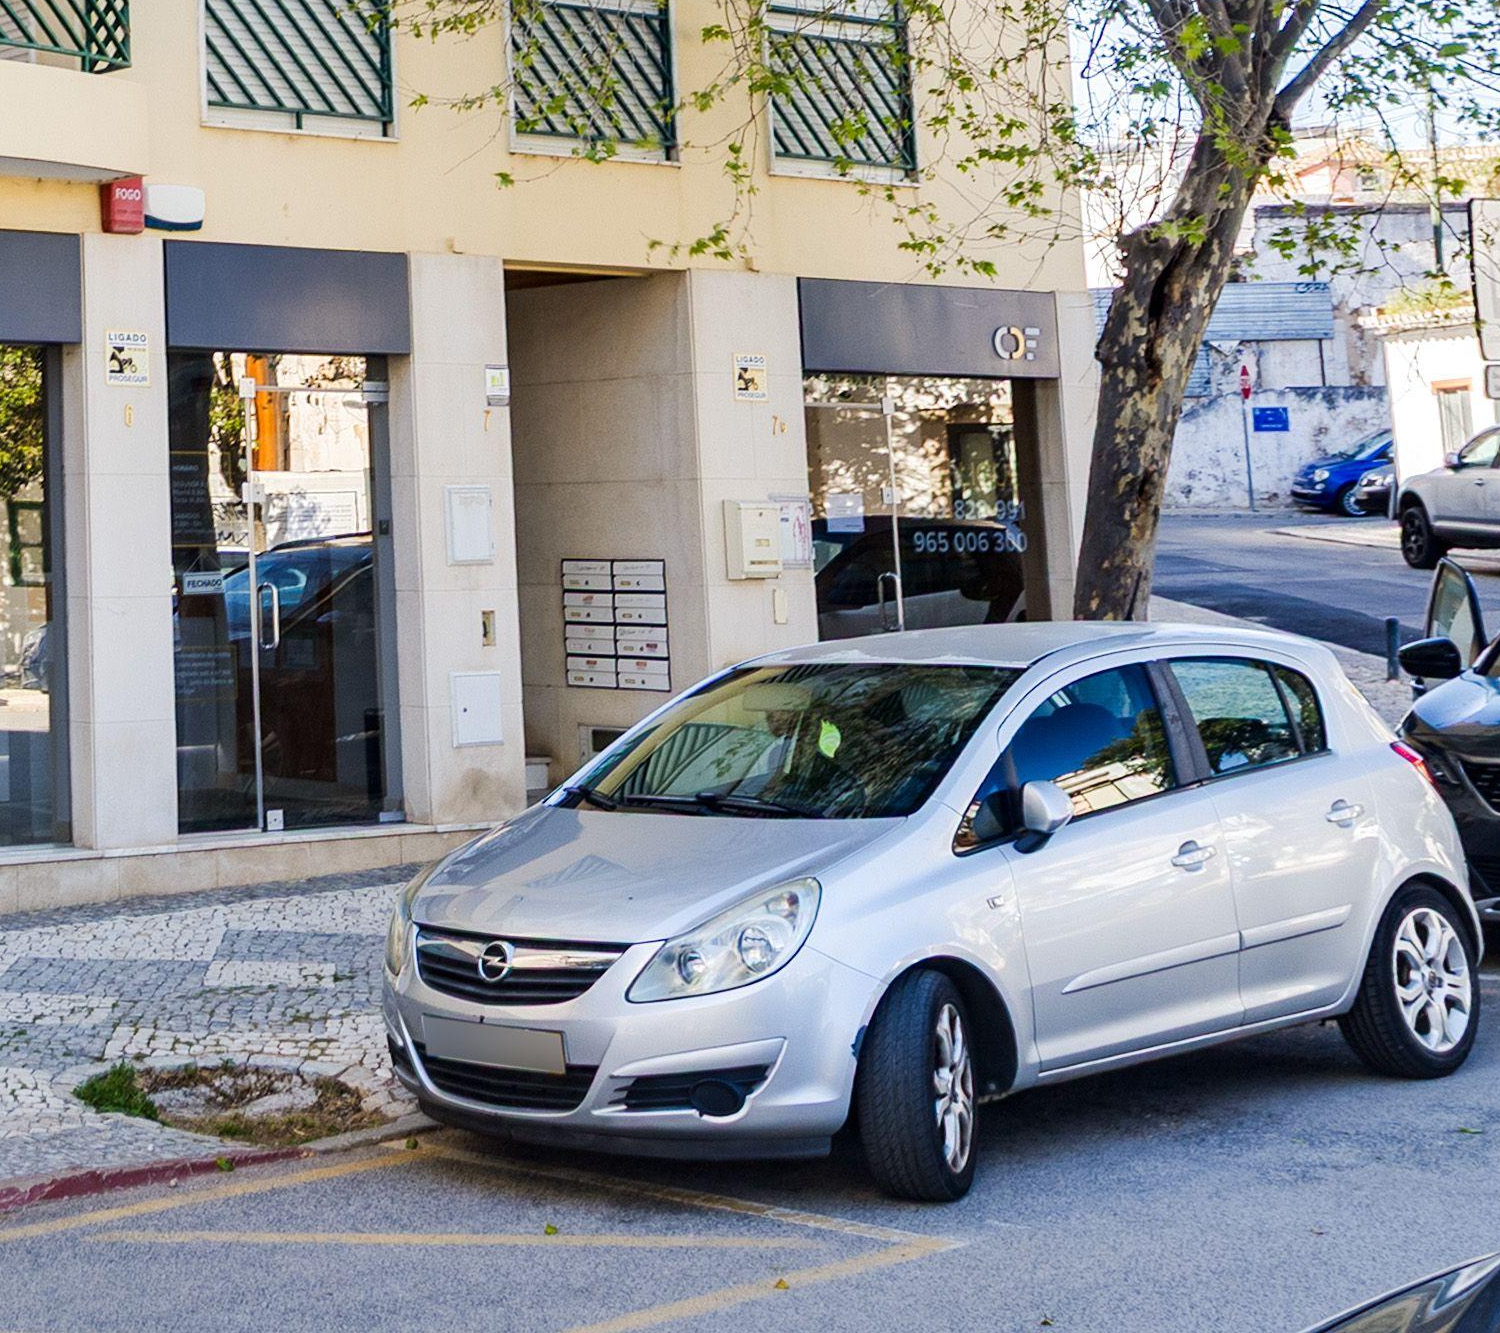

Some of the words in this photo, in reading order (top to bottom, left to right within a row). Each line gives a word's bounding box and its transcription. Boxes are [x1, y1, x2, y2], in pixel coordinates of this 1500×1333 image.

[115, 188, 141, 201] FOGO
[108, 333, 147, 342] LIGADO
[913, 531, 949, 552] 965
[954, 532, 989, 552] 006
[187, 579, 222, 588] FECHADO
